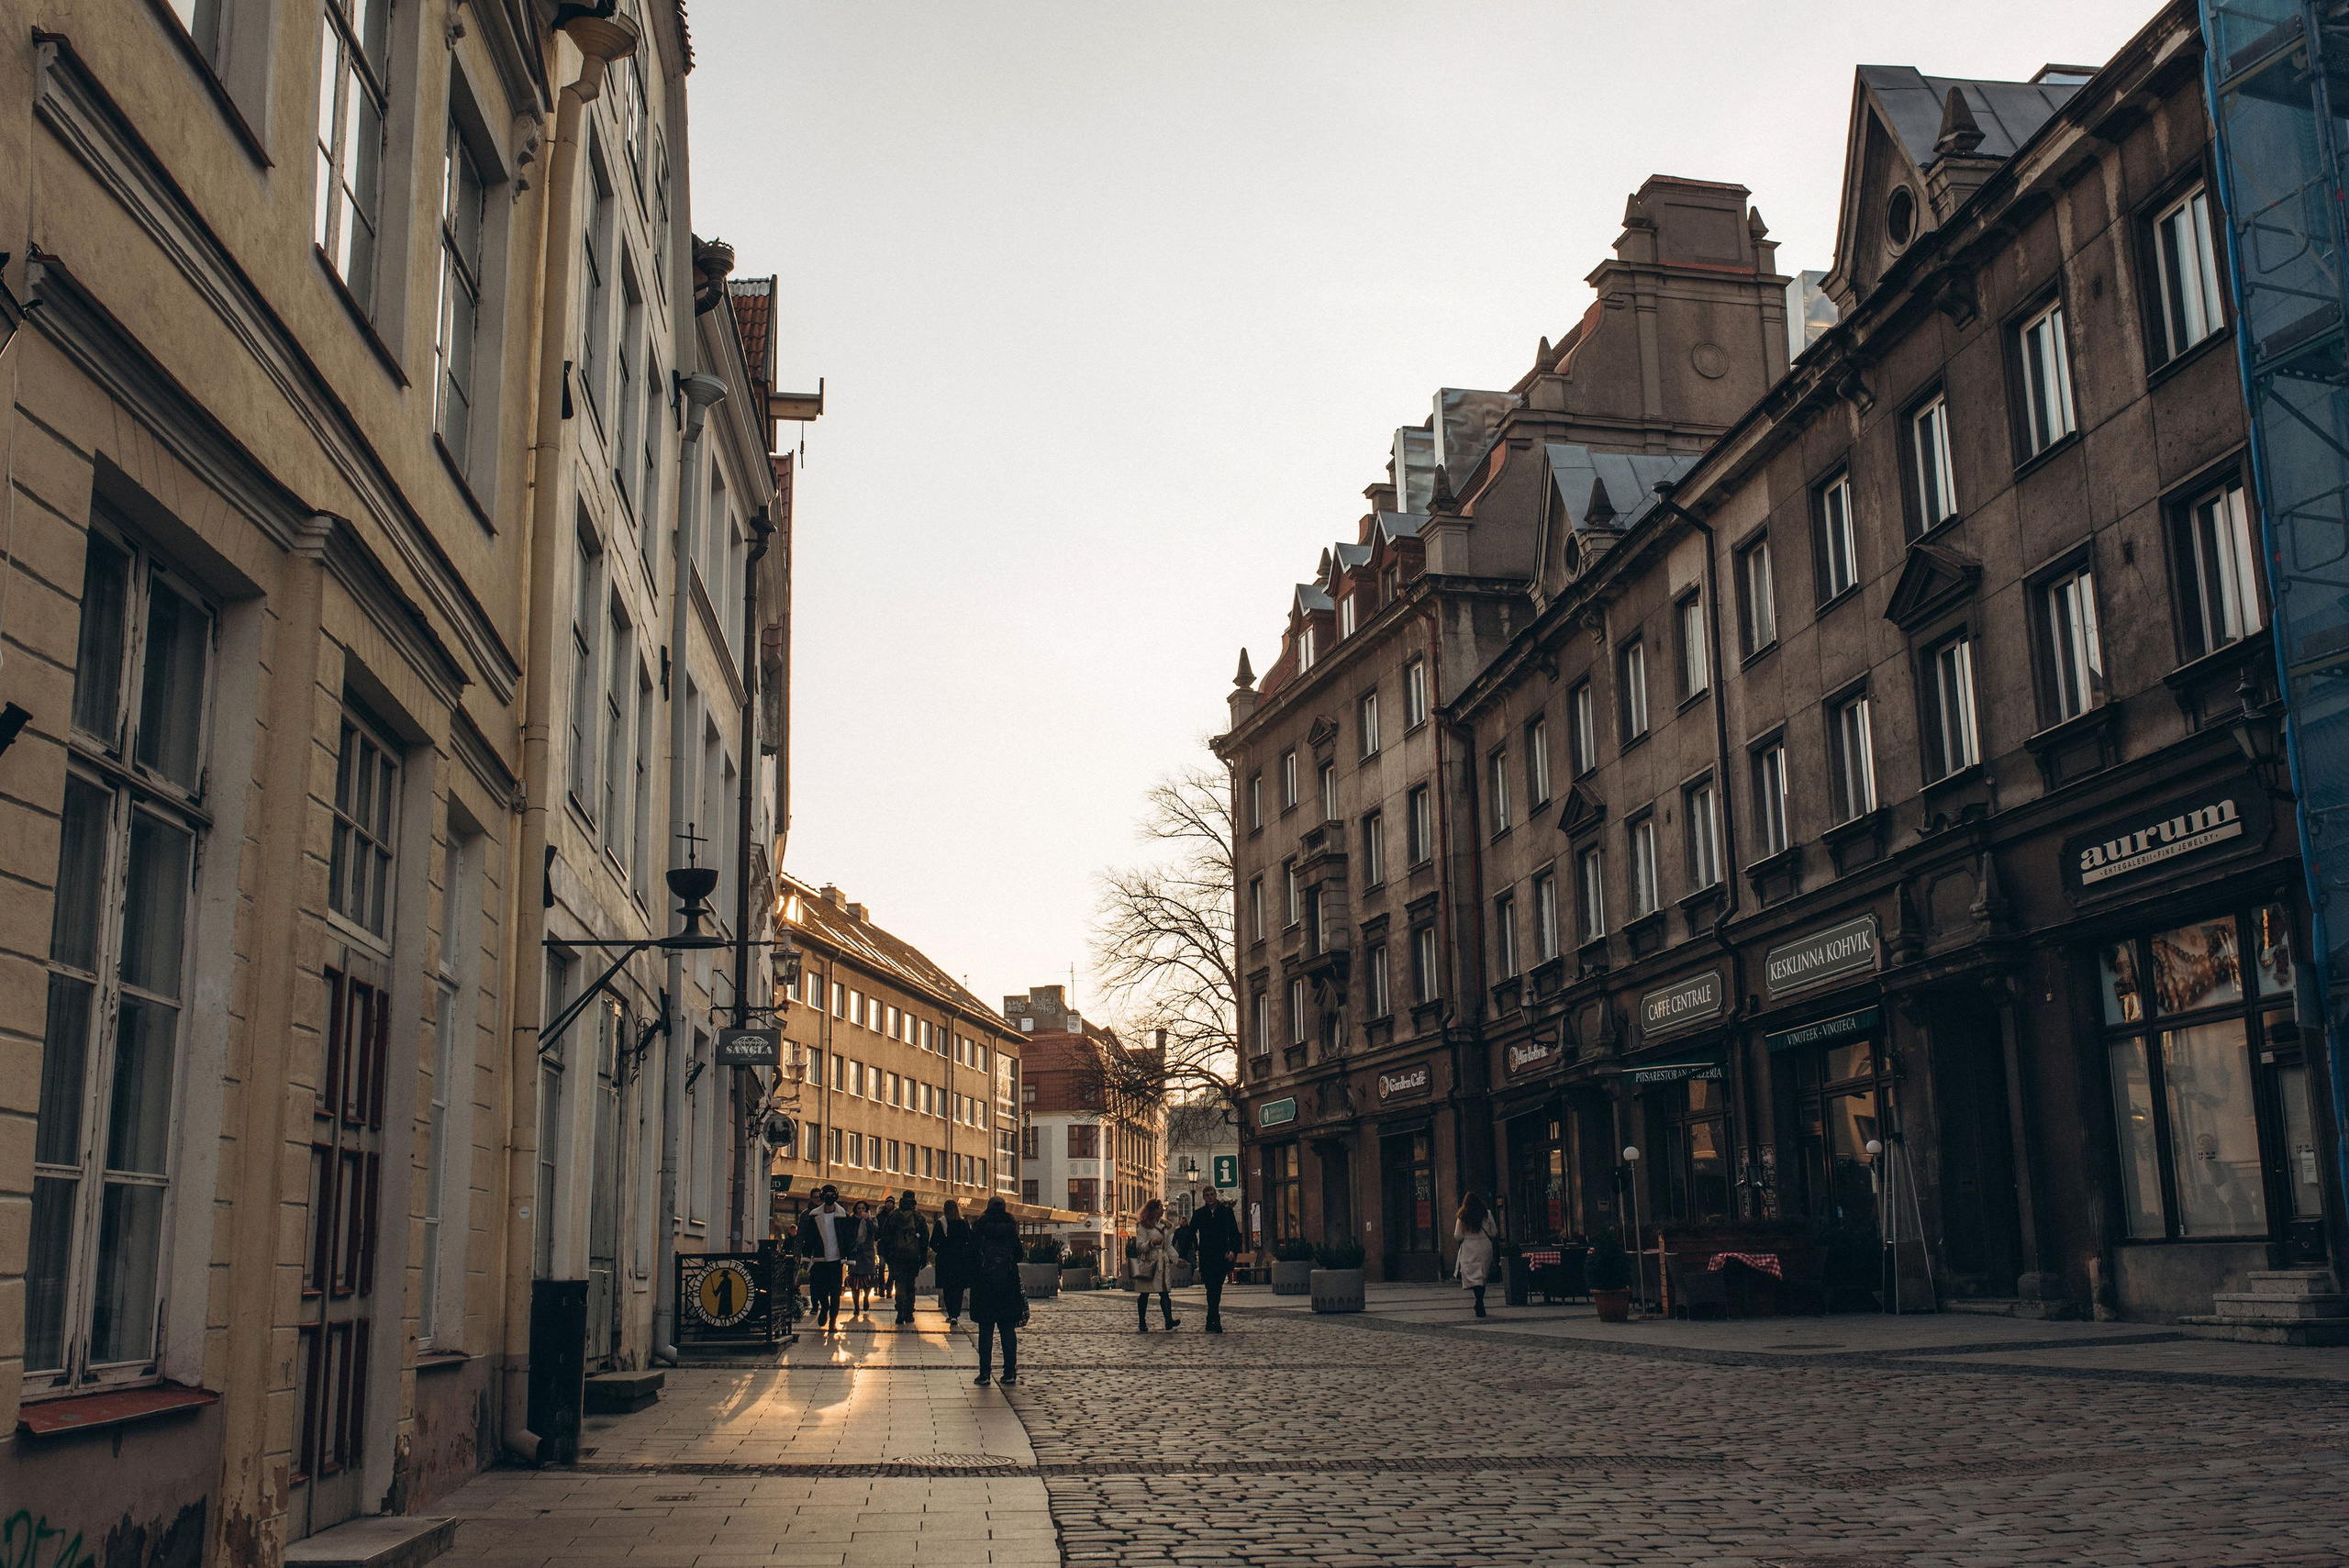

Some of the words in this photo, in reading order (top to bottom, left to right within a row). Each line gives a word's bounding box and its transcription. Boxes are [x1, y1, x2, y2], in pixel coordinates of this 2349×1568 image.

[2080, 799, 2239, 870] aurum
[2104, 855, 2153, 876] EHTEGALERII
[2156, 846, 2176, 858] FINE
[2177, 833, 2214, 852] JEWELRY
[1770, 947, 1825, 981] KESKLINNA
[1826, 929, 1871, 962] KOHVIK
[1648, 995, 1671, 1021] CAFFÈ
[1671, 984, 1711, 1013] CENTRALE
[1787, 1027, 1819, 1045] VINOTEEK
[1822, 1018, 1856, 1037] VINOTECA
[725, 1045, 773, 1055] SANGLA
[1389, 1075, 1412, 1092] Garden
[1635, 1069, 1687, 1083] PITSARESTORAN
[729, 1261, 755, 1301] LEGENDID
[695, 1306, 717, 1326] ANNO
